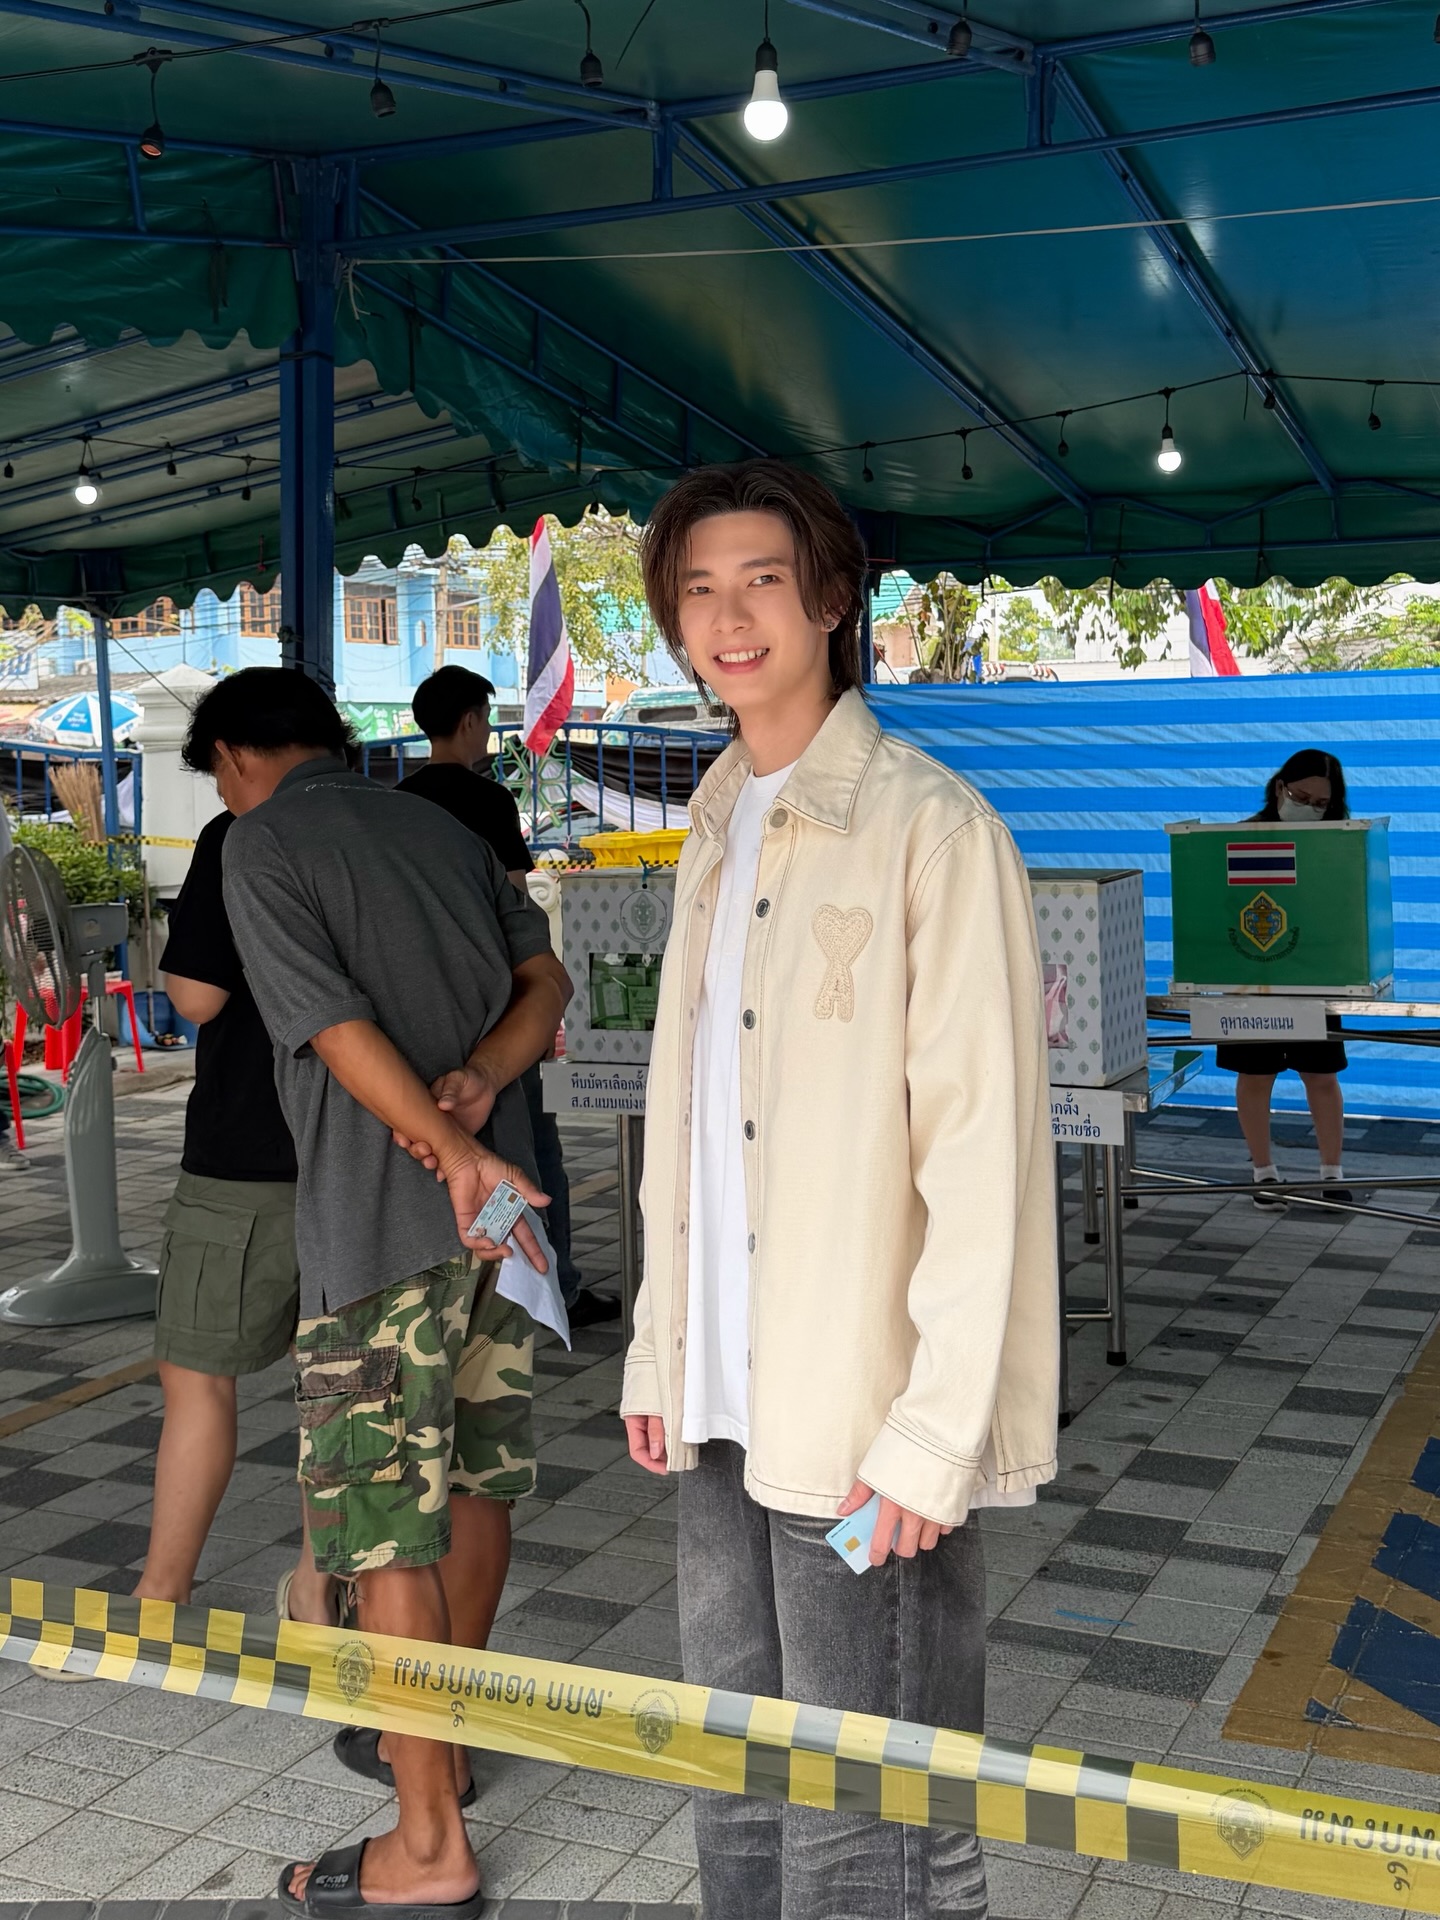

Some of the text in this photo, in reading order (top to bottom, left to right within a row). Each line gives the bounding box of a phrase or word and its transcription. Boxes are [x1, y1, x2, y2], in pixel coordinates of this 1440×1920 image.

[1220, 1016, 1294, 1035] คูหาลงคะแนน
[1051, 1092, 1079, 1115] กตั้ง
[1052, 1114, 1101, 1137] ชีรายชื่อ
